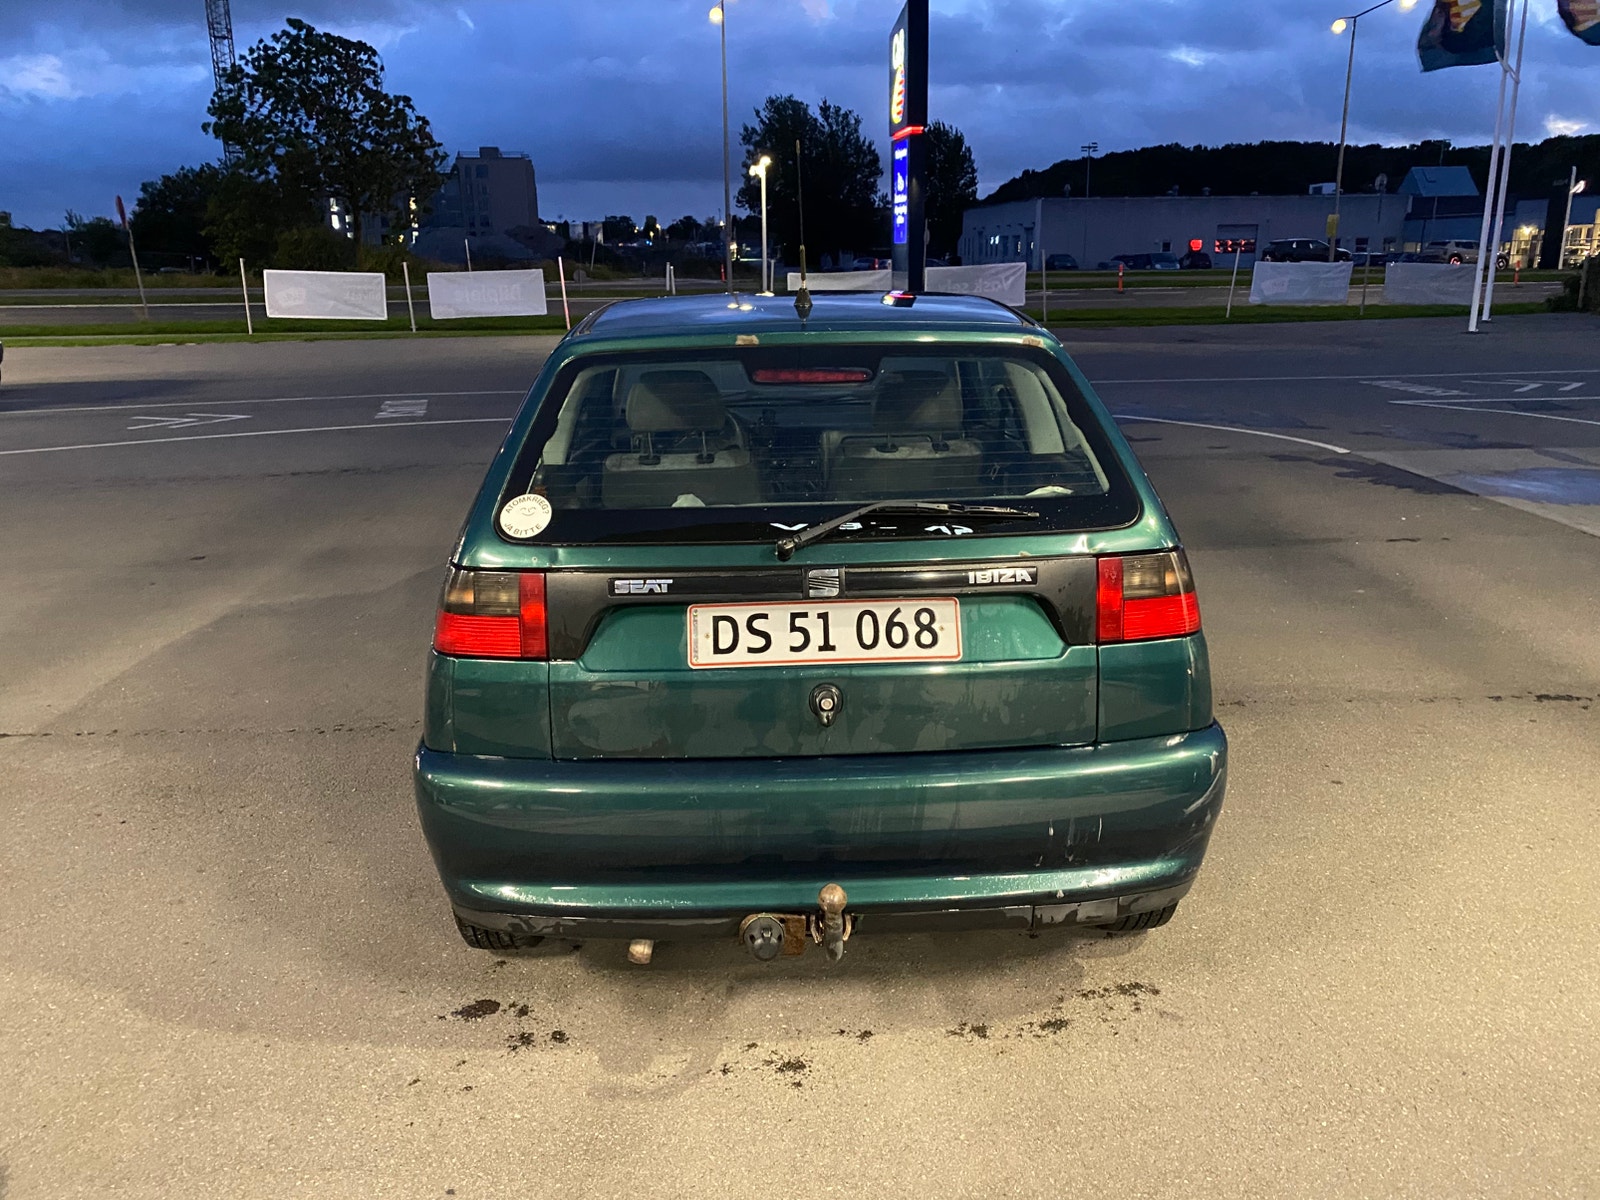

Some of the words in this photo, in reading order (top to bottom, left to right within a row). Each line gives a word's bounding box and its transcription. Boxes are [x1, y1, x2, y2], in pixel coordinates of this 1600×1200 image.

[505, 496, 550, 514] ATOMKRIEG?
[504, 523, 513, 531] JA
[513, 523, 542, 535] BITTE
[968, 568, 1032, 584] IBIZA
[614, 579, 673, 593] SEAT
[712, 612, 772, 655] DS
[789, 611, 836, 652] 51
[856, 607, 939, 650] 068
